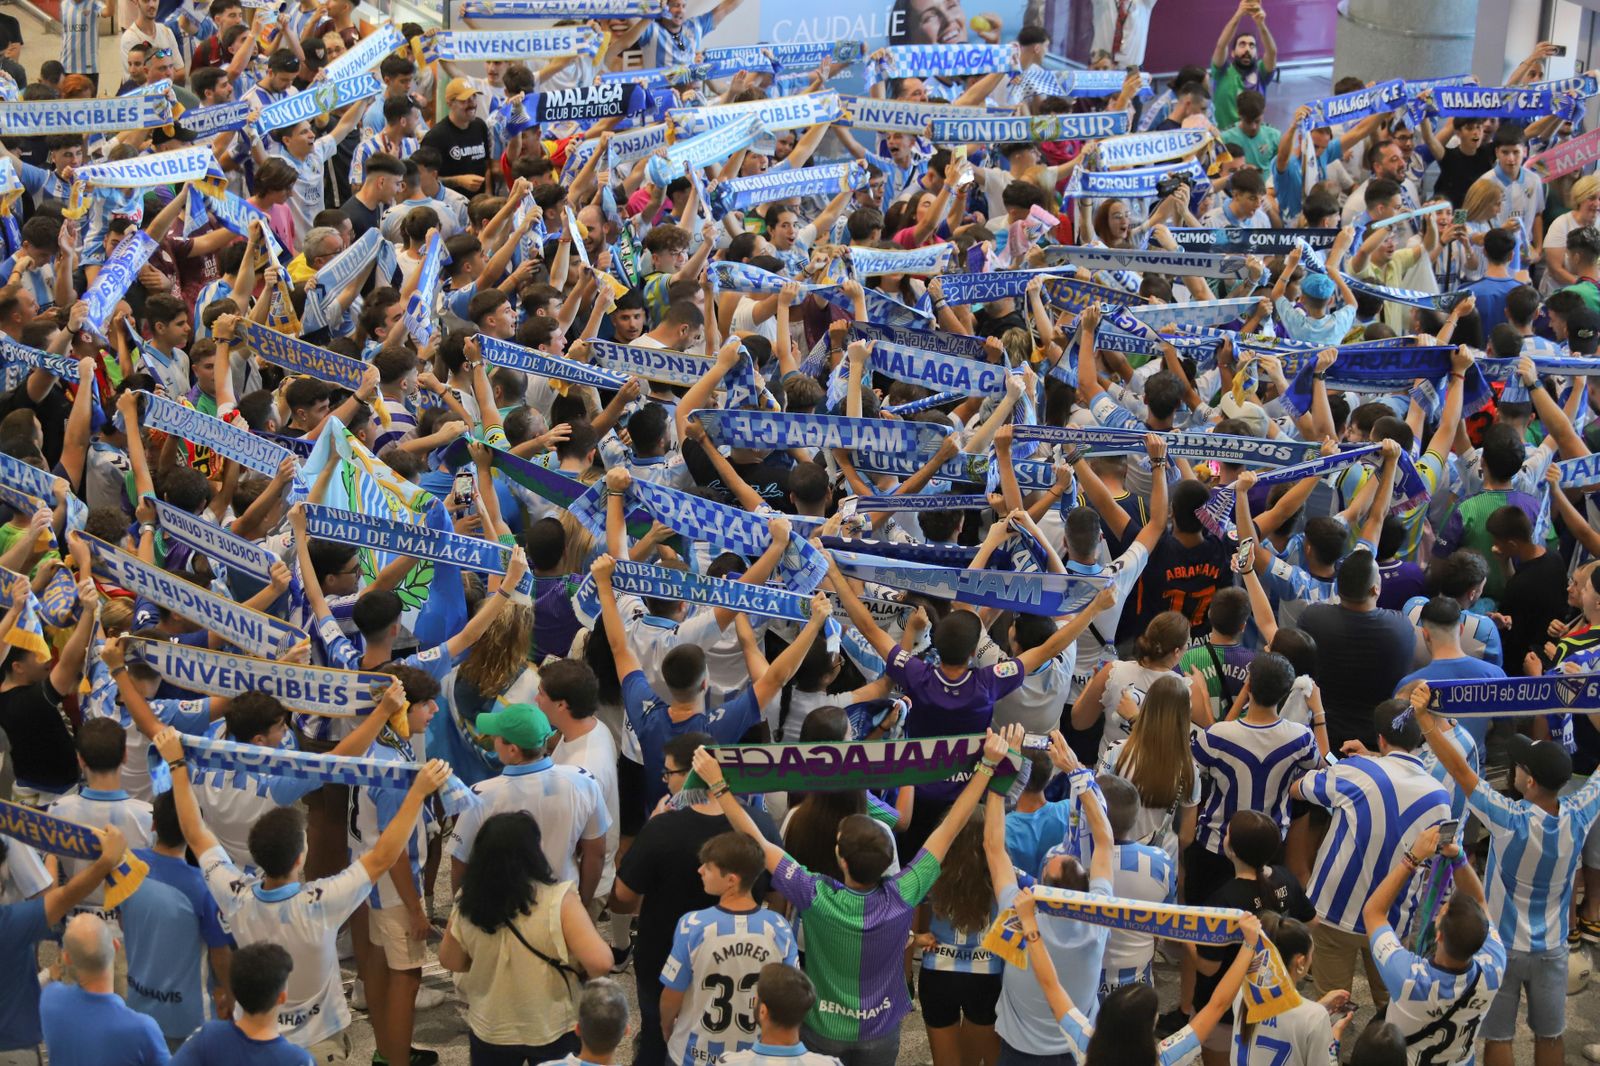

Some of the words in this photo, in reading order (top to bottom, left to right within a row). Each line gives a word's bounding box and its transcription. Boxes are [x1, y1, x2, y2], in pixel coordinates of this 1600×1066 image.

[458, 36, 571, 54] INVENCIBLES
[334, 37, 389, 80] INVENCIBLES
[911, 49, 994, 70] MALAGA
[339, 76, 377, 101] SUR
[1328, 94, 1371, 118] MALAGA
[1441, 92, 1502, 109] MALAGA
[1517, 93, 1544, 108] C.F.
[6, 106, 140, 128] INVENCIBLES
[545, 106, 568, 121] CLUB
[570, 105, 583, 118] DE
[943, 120, 1029, 141] FONDO
[1063, 119, 1116, 137] SUR
[1107, 131, 1203, 160] INVENCIBLES
[731, 165, 846, 193] INCONDICIONALES
[1087, 174, 1141, 190] PORQUE
[1143, 175, 1157, 188] TE
[1249, 231, 1276, 245] CON
[521, 354, 542, 371] DE
[871, 347, 972, 390] MALAGA
[153, 400, 194, 432] 100%
[195, 417, 282, 468] MALAGUISTA
[1167, 446, 1204, 458] DEFENDER
[1216, 450, 1244, 460] ESCUDO
[1014, 462, 1055, 487] SU
[366, 528, 390, 547] DE
[397, 534, 482, 565] MÁLAGA
[1166, 563, 1221, 582] ABRAHAM
[658, 583, 683, 598] DE
[123, 561, 263, 644] INVENCIBLES
[166, 646, 253, 672] JUNTOS
[271, 665, 350, 686] SOMOS
[165, 655, 349, 706] INVENCIBLES
[712, 942, 770, 965] AMORES
